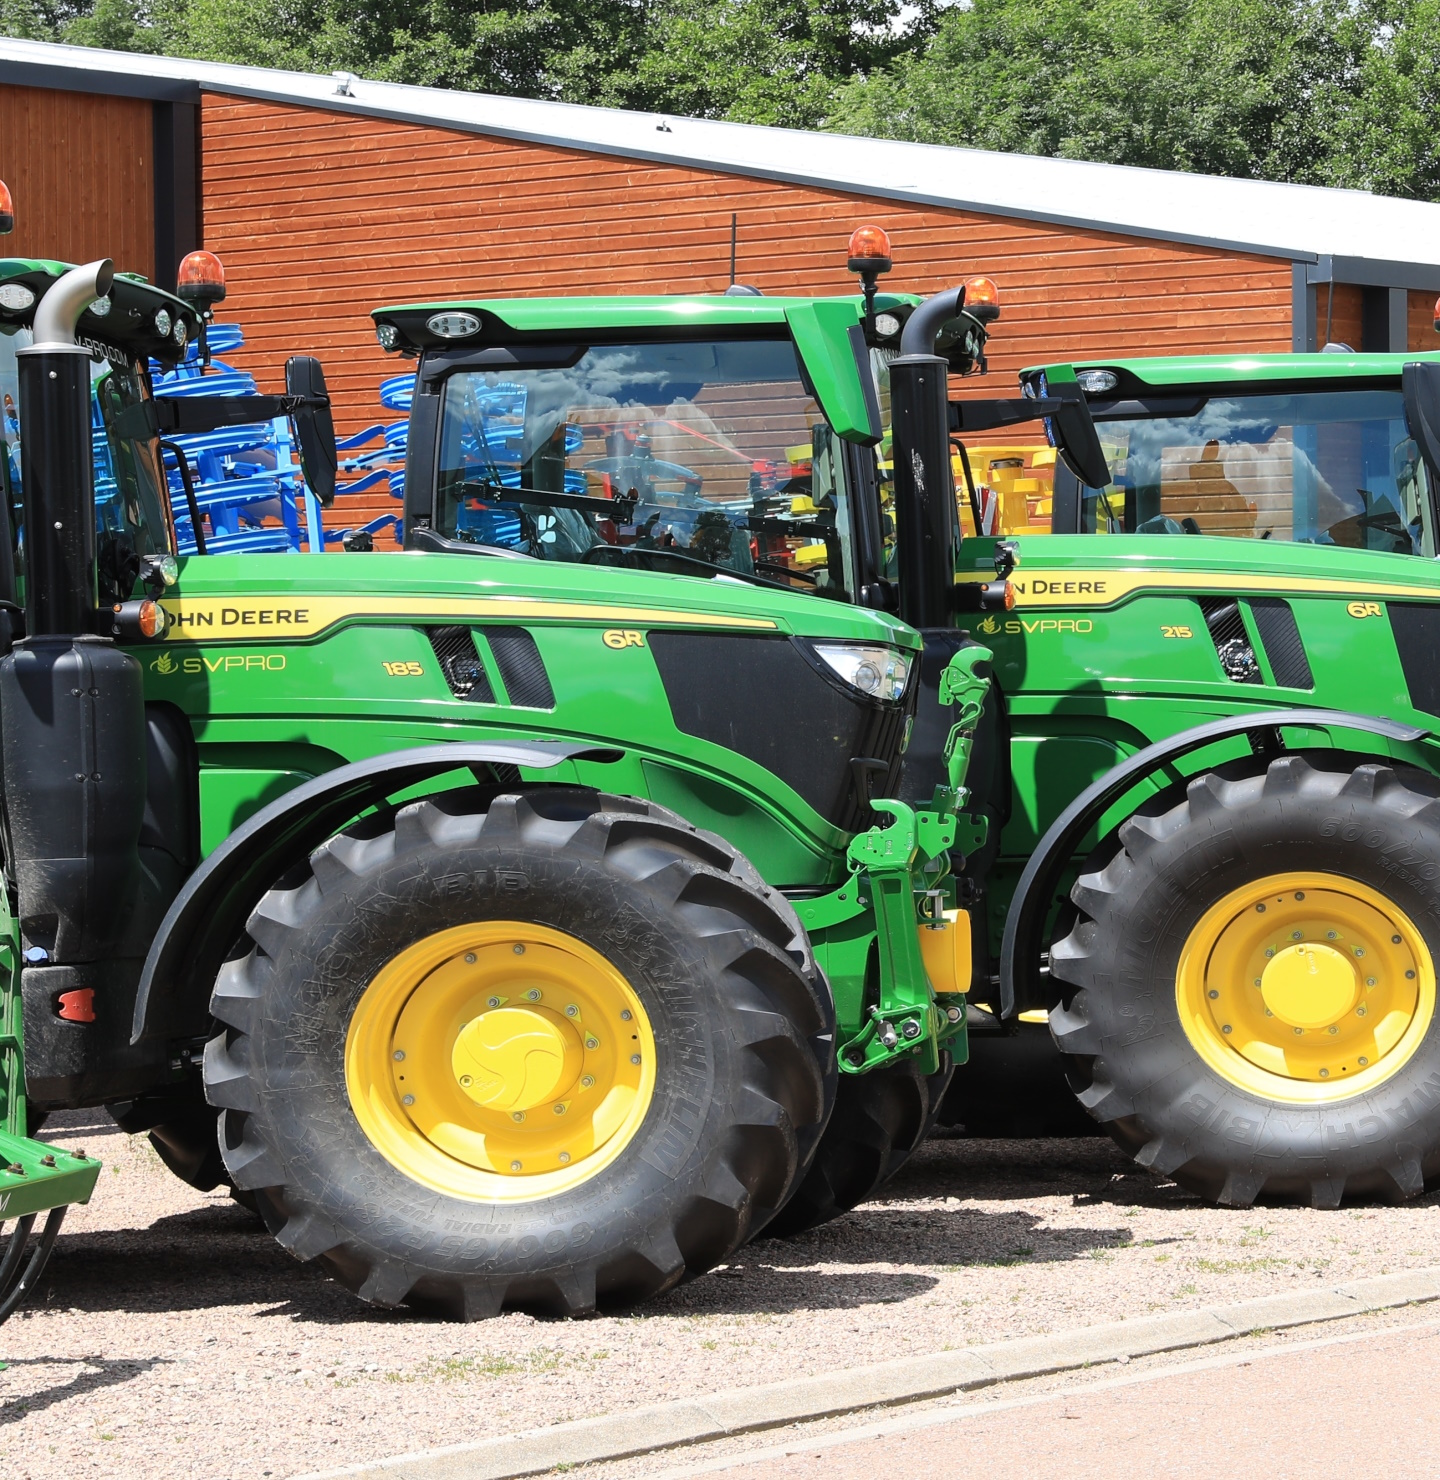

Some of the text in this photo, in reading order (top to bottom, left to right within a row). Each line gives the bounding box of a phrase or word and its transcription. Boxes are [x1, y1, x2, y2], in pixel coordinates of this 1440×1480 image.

[1032, 580, 1106, 594] DEERE
[221, 608, 309, 625] DEERE
[1346, 602, 1382, 618] 6R
[1005, 619, 1093, 634] SVPRO
[1160, 625, 1193, 639] 215
[602, 629, 645, 650] 6R
[183, 655, 286, 674] SVPRO
[381, 661, 424, 677] 185
[1376, 855, 1430, 896] RADIAL
[1119, 834, 1235, 990] MICHELIN
[352, 1173, 512, 1236] RADIAL TUBELESS
[351, 1202, 594, 1262] 600/65 R28
